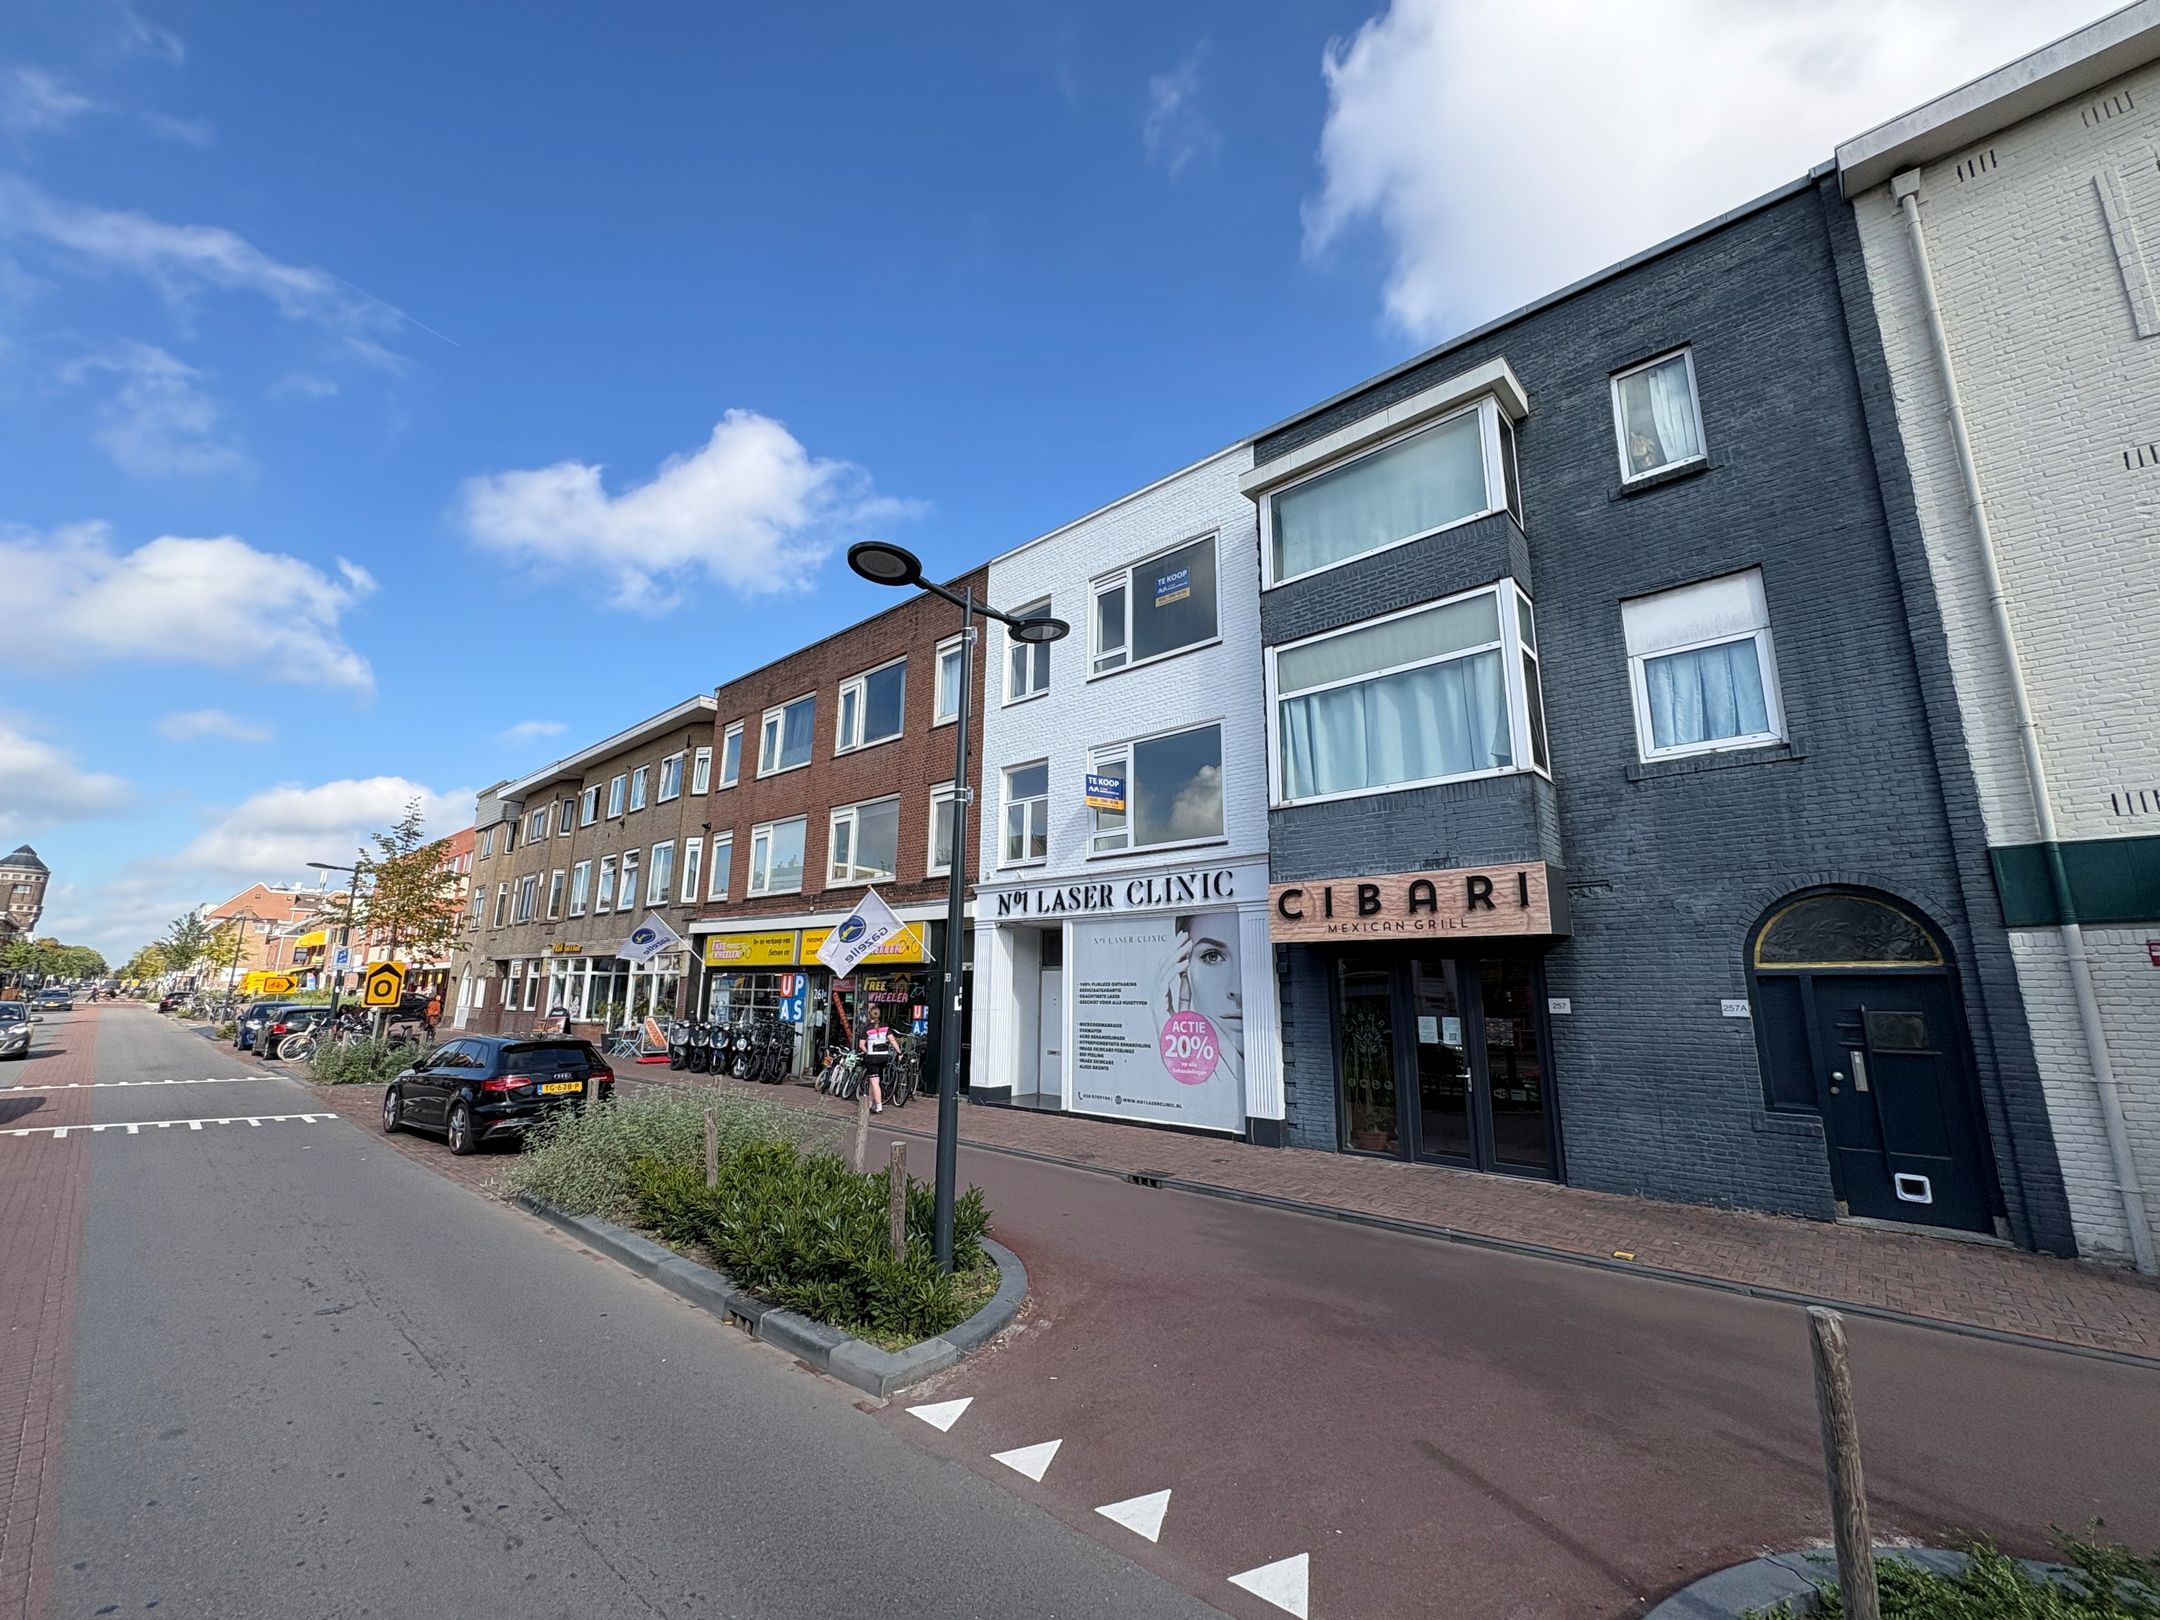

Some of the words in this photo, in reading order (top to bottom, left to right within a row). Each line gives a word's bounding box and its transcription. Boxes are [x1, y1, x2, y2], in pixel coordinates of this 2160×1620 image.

[1157, 578, 1166, 586] TE
[1166, 569, 1188, 583] KOOP
[1087, 776, 1097, 785] TE
[1098, 778, 1120, 787] KOOP
[1037, 884, 1114, 913] LASER
[1126, 870, 1234, 905] CLINIC
[1278, 871, 1530, 919] CIBARI
[1328, 921, 1405, 933] MEXICAN
[1414, 918, 1469, 931] GRILL
[1108, 936, 1135, 945] LASER
[1137, 934, 1167, 944] CLINIC
[863, 976, 887, 991] FREE
[868, 991, 909, 1003] WHEELER
[1552, 1002, 1567, 1010] 257
[1723, 1004, 1748, 1012] 257A
[1172, 1020, 1206, 1033] ACTIE
[1164, 1034, 1214, 1060] 20%
